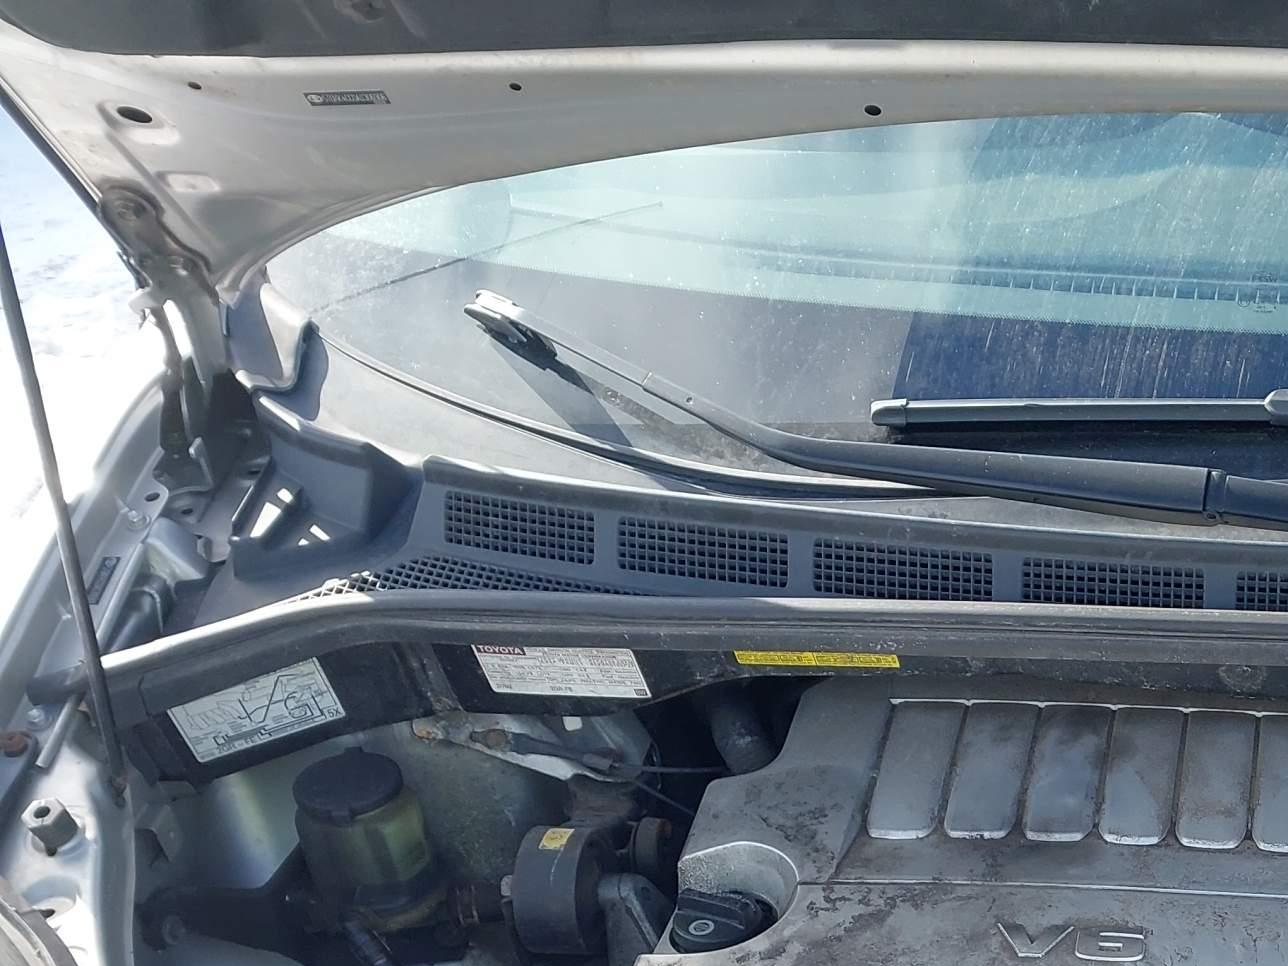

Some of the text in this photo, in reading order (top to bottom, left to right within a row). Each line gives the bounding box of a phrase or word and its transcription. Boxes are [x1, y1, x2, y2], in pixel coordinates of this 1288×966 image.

[477, 645, 524, 655] TOYOTA
[327, 708, 342, 718] 5X
[997, 922, 1146, 962] V6
